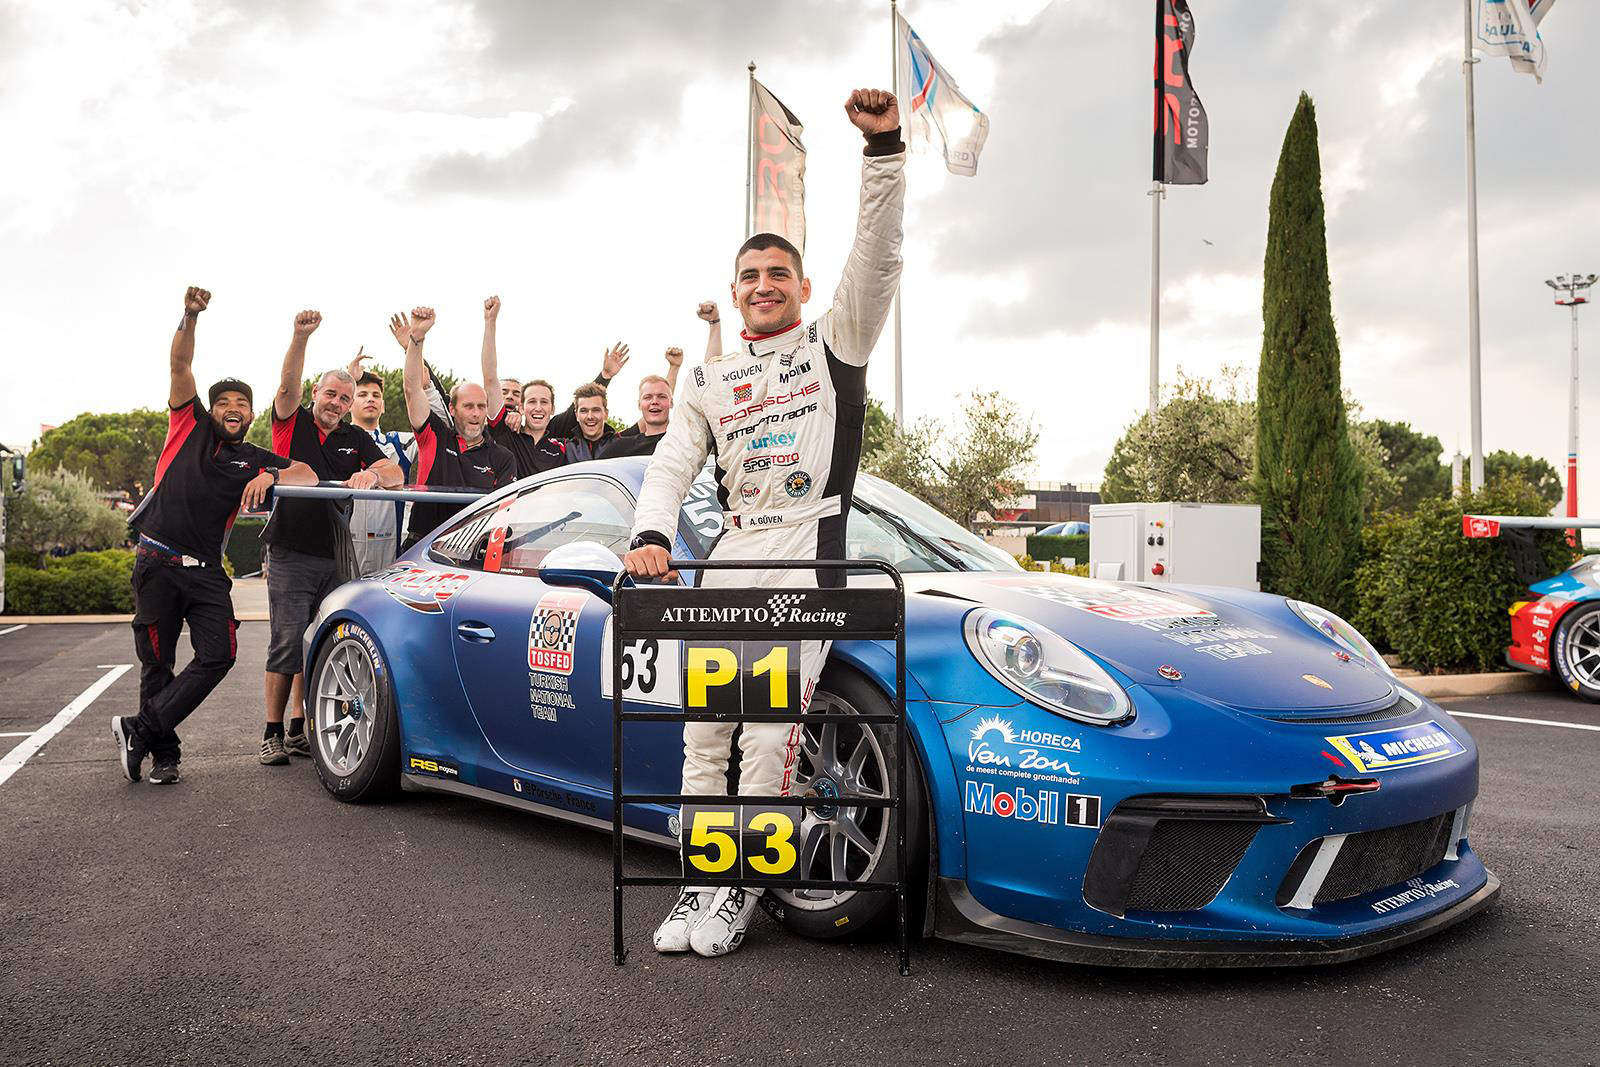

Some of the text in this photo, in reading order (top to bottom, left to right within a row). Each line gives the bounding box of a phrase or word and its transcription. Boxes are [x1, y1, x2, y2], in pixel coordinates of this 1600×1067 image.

[719, 381, 820, 427] PORSCHE
[758, 514, 783, 525] GÜVEN
[661, 607, 847, 627] ATTEMPTO Racing
[350, 624, 381, 670] MICHELIN
[1193, 641, 1273, 661] TEAM
[531, 651, 570, 670] TOSFED
[529, 672, 569, 692] TURKISH
[530, 688, 576, 709] NATIONAL
[531, 704, 557, 722] TEAM
[1020, 729, 1082, 750] HORECA
[1381, 731, 1451, 757] MICHELIN
[410, 757, 438, 772] RS
[968, 740, 1081, 776] Van Zon
[965, 764, 1080, 785] de meest complete groothandel
[965, 780, 1059, 825] Mobil
[1371, 878, 1461, 915] ATTEMPTO Racing
